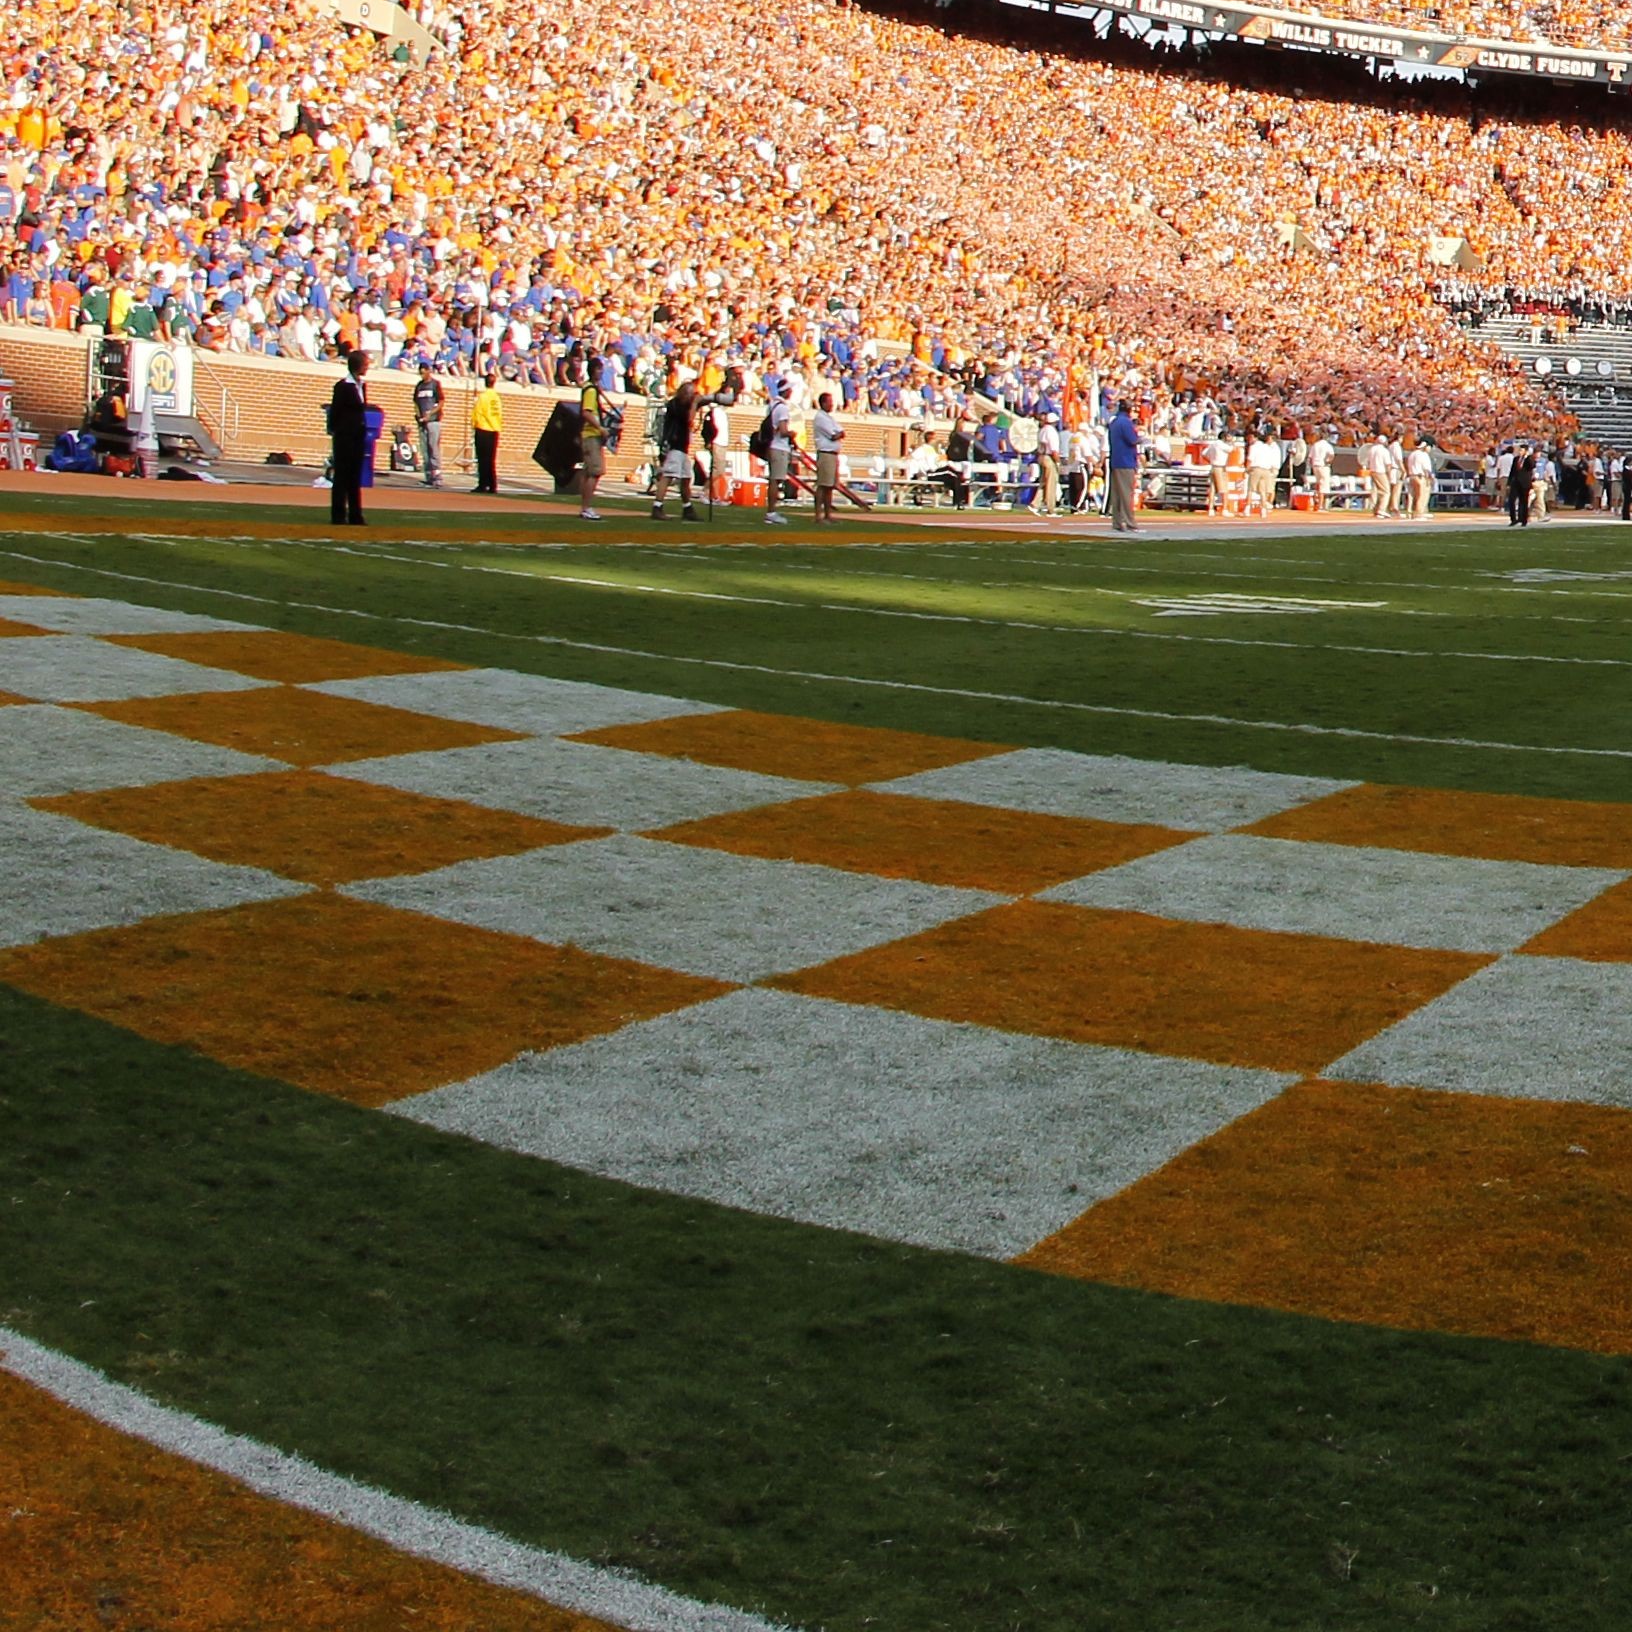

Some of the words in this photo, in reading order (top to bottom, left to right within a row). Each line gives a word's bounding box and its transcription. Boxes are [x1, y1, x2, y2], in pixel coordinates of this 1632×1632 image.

[1271, 20, 1331, 46] WILLIS
[1334, 32, 1404, 56] TUCKER
[1476, 50, 1532, 69] CLYDE
[1535, 56, 1597, 77] FUSON
[1606, 62, 1627, 82] T
[2, 394, 12, 410] G
